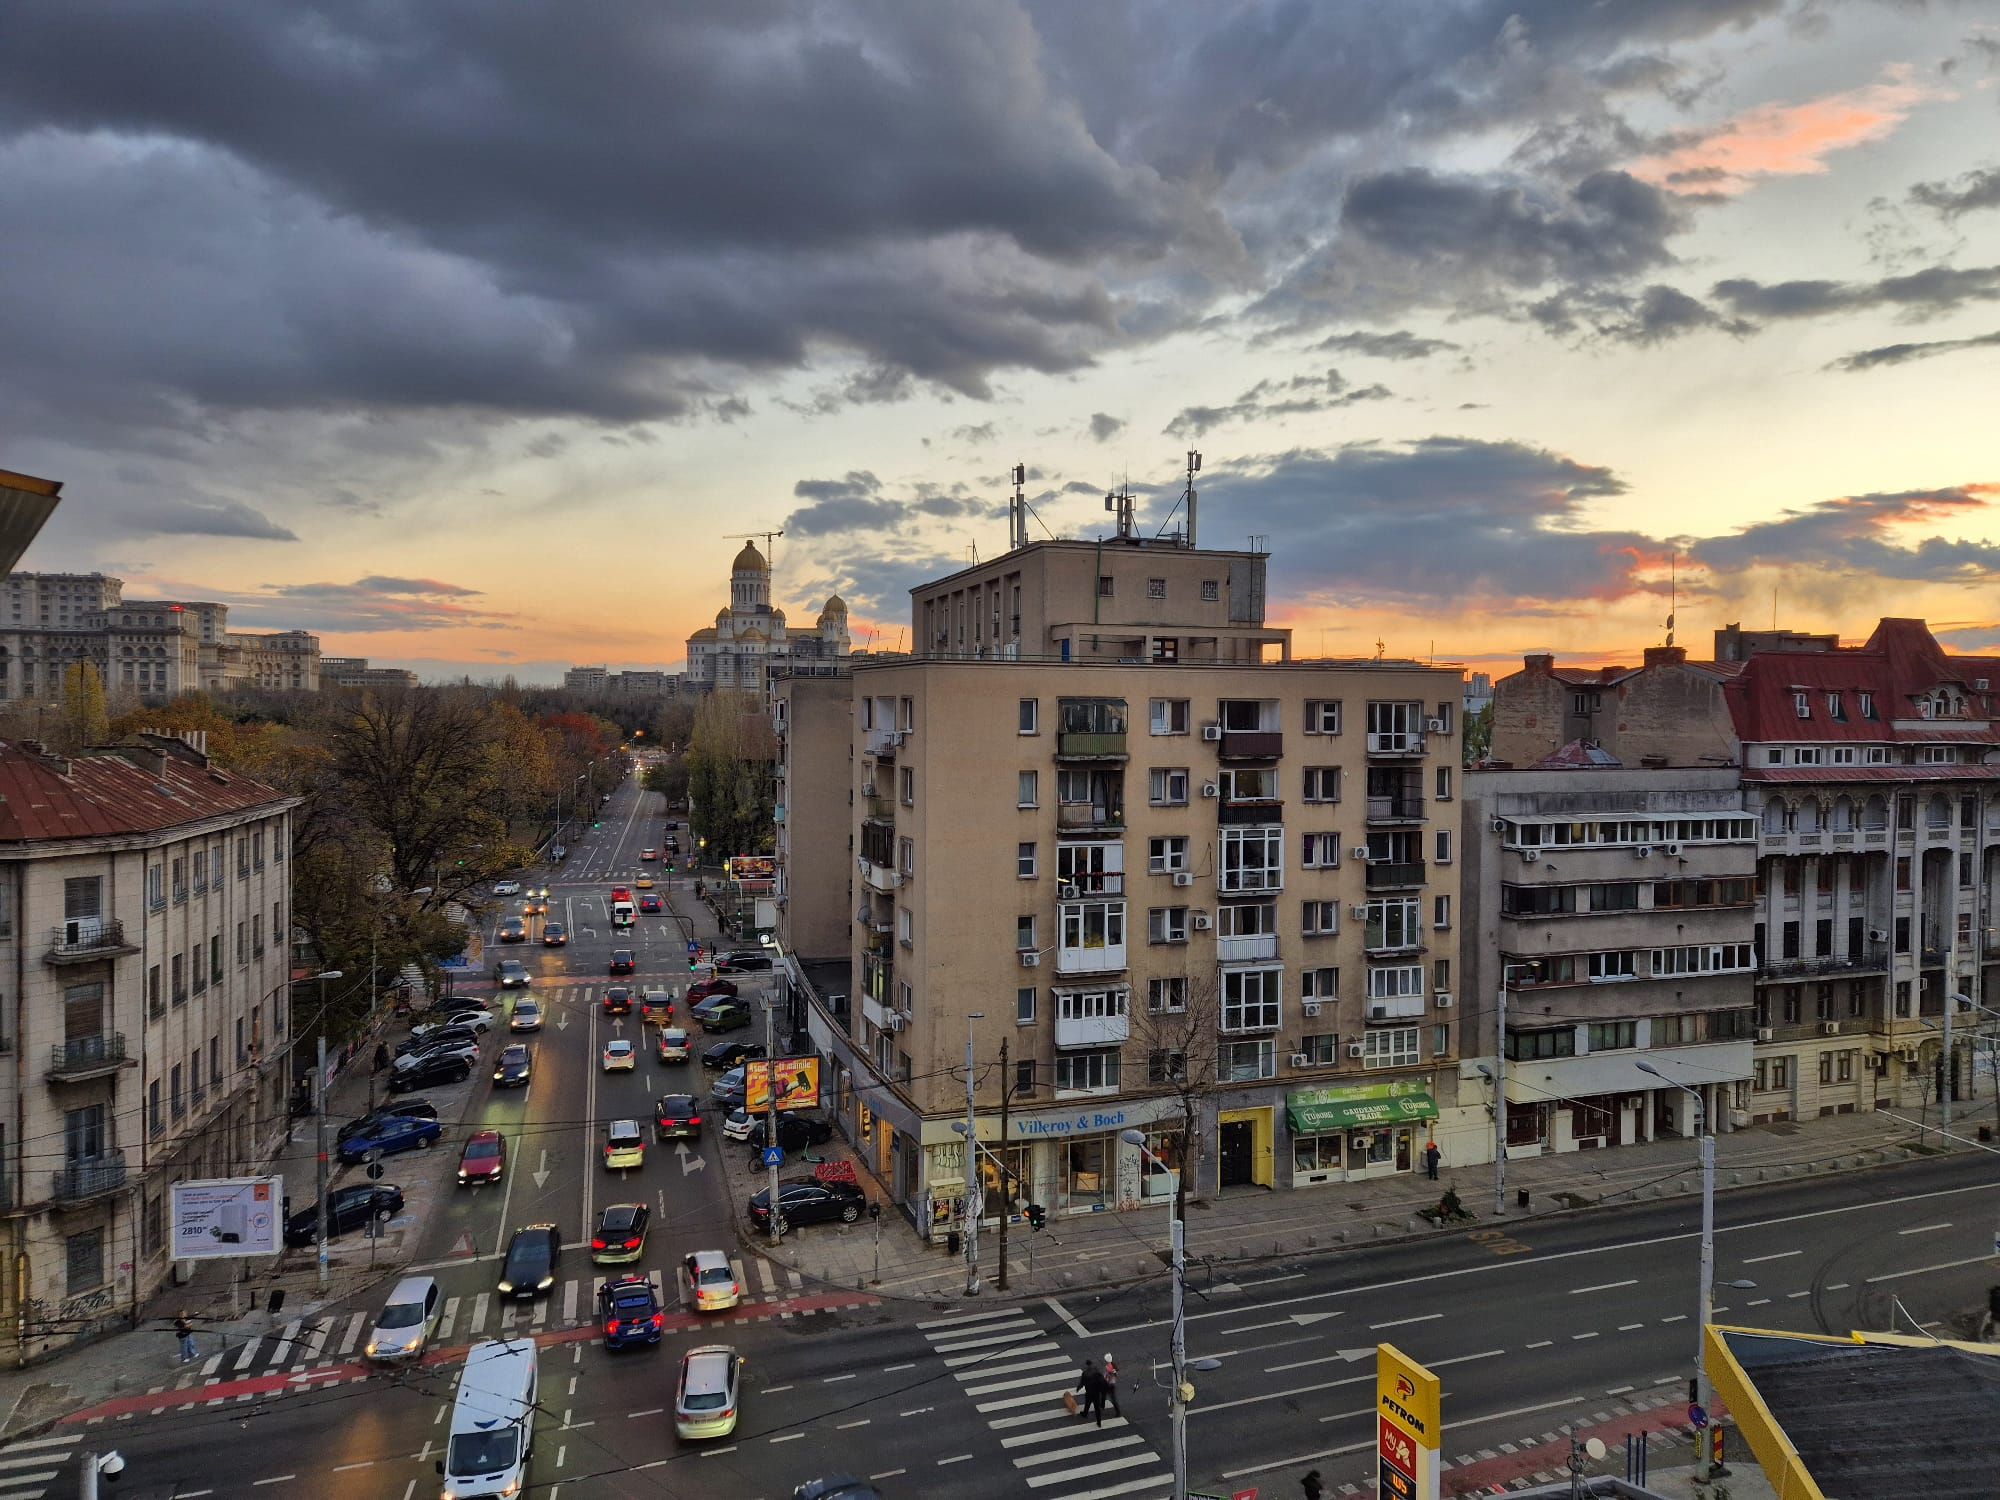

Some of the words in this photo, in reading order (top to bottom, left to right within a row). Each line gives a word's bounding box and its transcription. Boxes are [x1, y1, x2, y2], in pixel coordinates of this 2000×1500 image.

[1343, 1105, 1390, 1115] GAUDEAMUS
[1404, 1101, 1430, 1110] TUBORG
[1306, 1111, 1333, 1120] TUBORG
[1356, 1111, 1383, 1121] TRADE
[1018, 1121, 1072, 1133] Villeroy
[1077, 1116, 1088, 1128] &
[1094, 1111, 1124, 1126] Boch
[182, 1226, 203, 1236] 2810
[1382, 1395, 1424, 1434] PETROM
